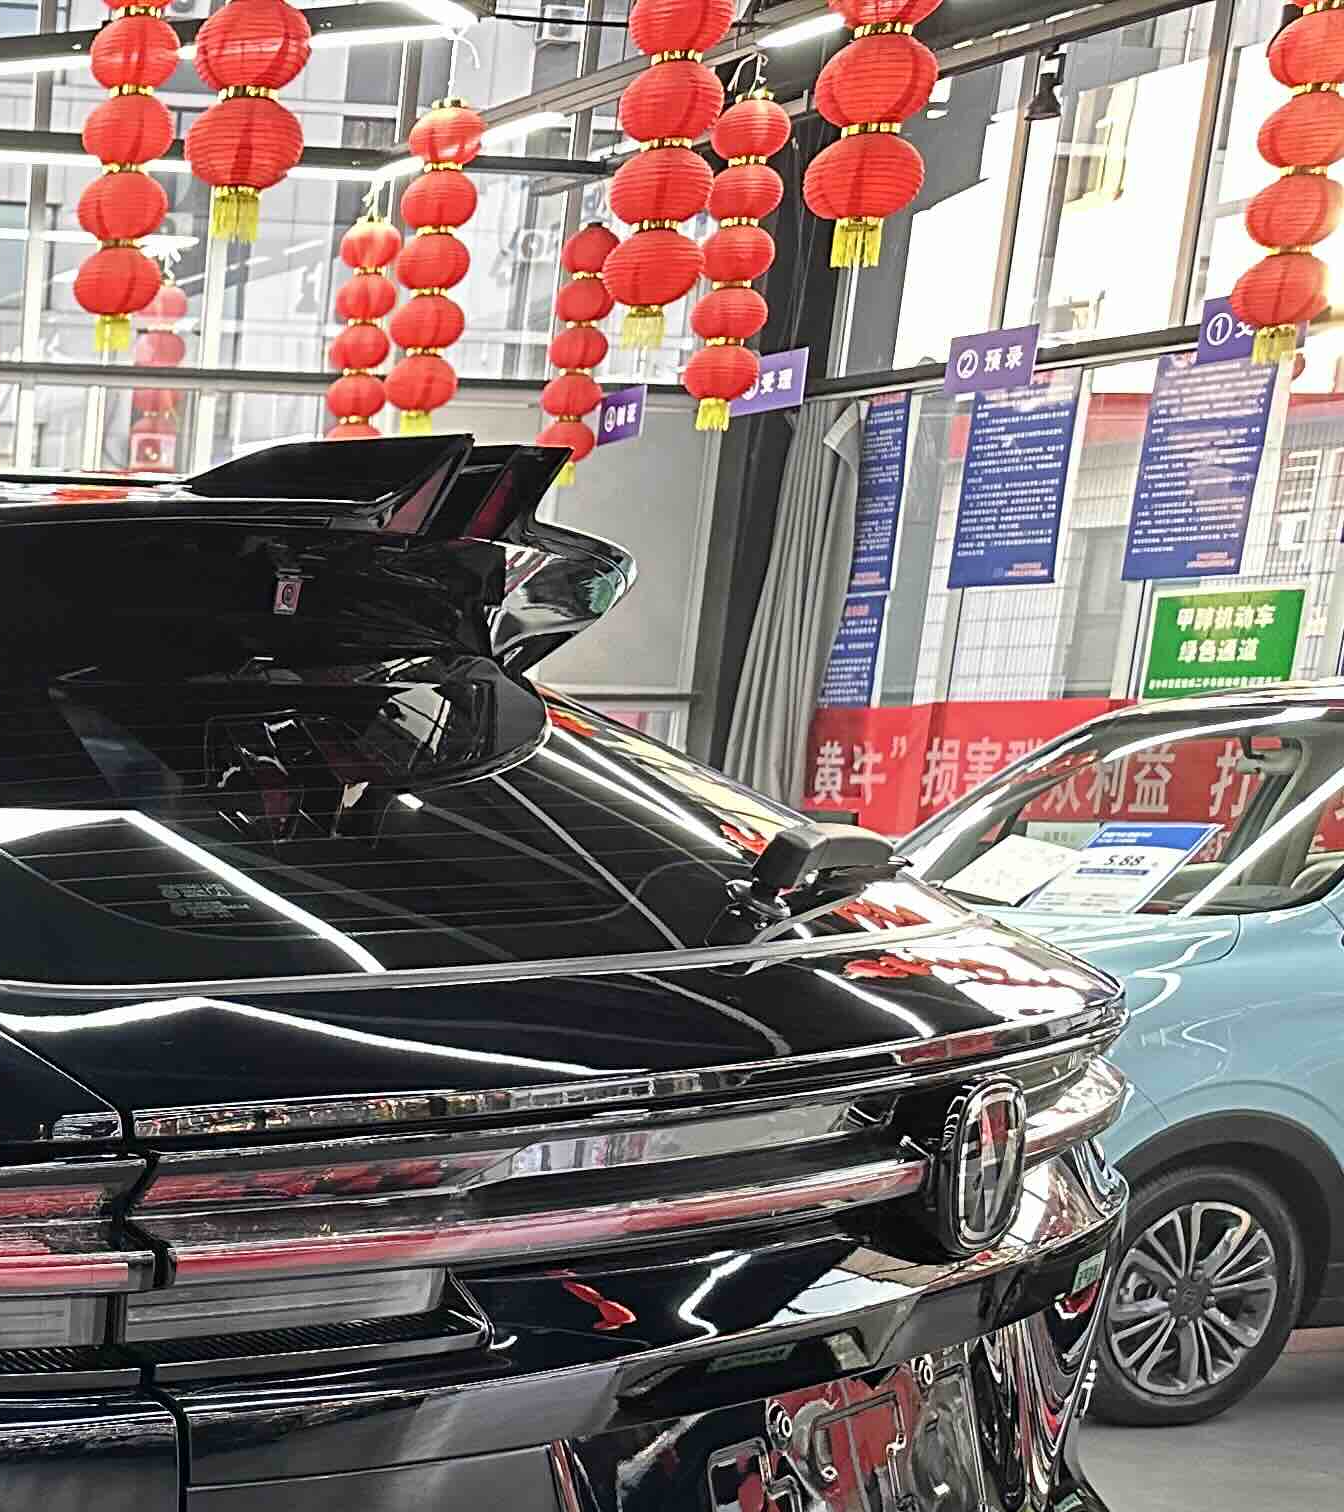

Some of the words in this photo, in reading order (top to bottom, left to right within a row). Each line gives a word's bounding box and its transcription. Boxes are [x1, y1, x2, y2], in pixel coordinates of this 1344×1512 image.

[760, 367, 793, 395] 受理
[1176, 637, 1260, 663] 绿色通道
